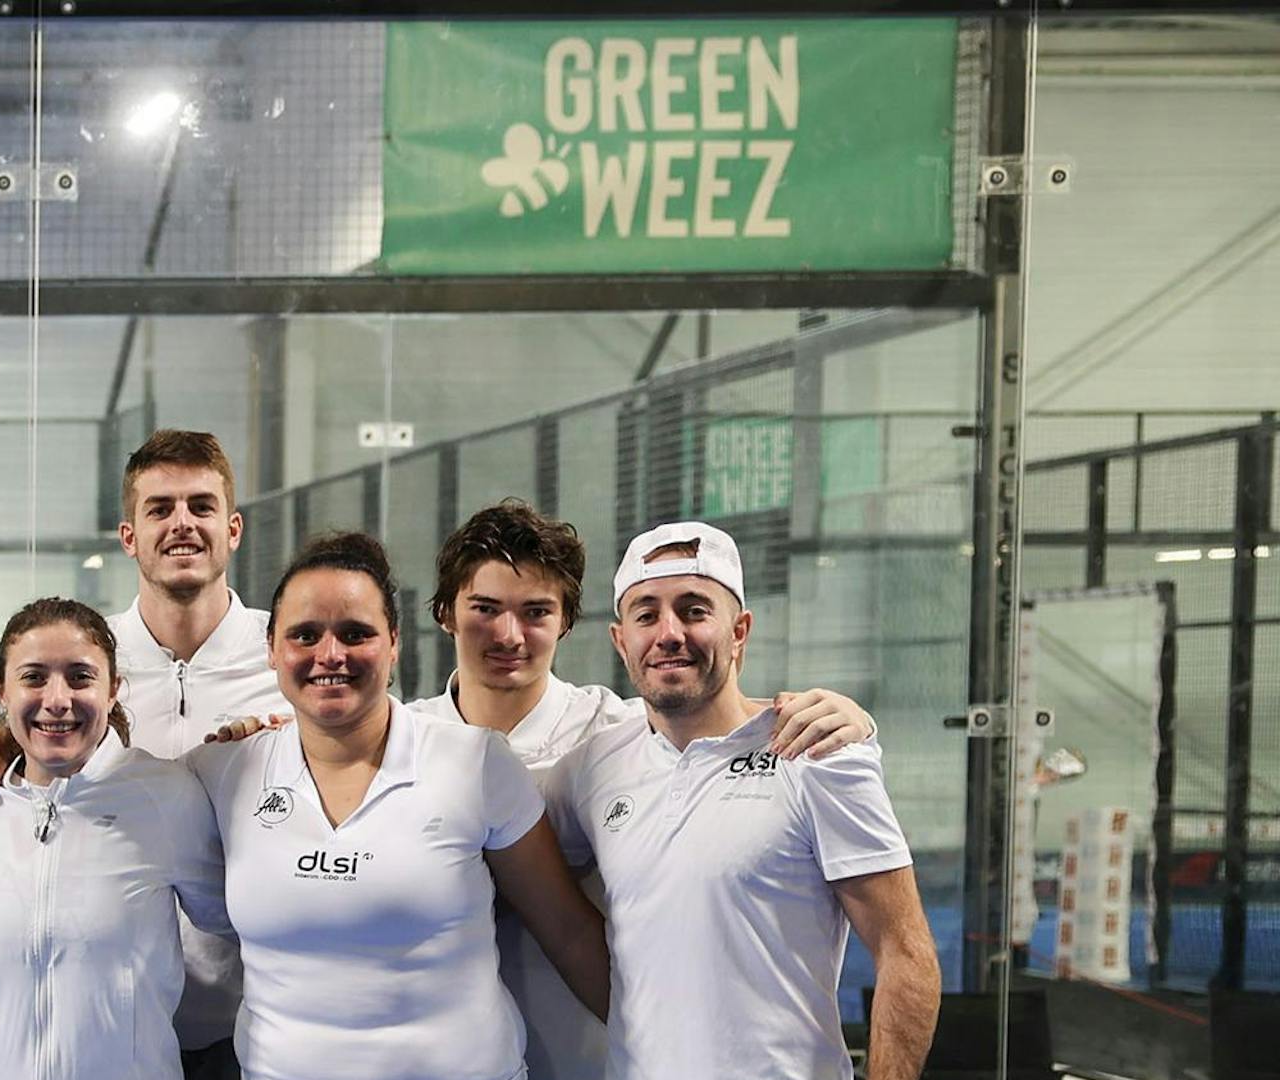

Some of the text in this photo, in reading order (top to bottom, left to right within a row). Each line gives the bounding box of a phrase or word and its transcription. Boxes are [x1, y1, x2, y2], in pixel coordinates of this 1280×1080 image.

[544, 36, 800, 134] GREEN
[579, 139, 796, 238] WEEZ
[297, 850, 358, 874] dlsi
